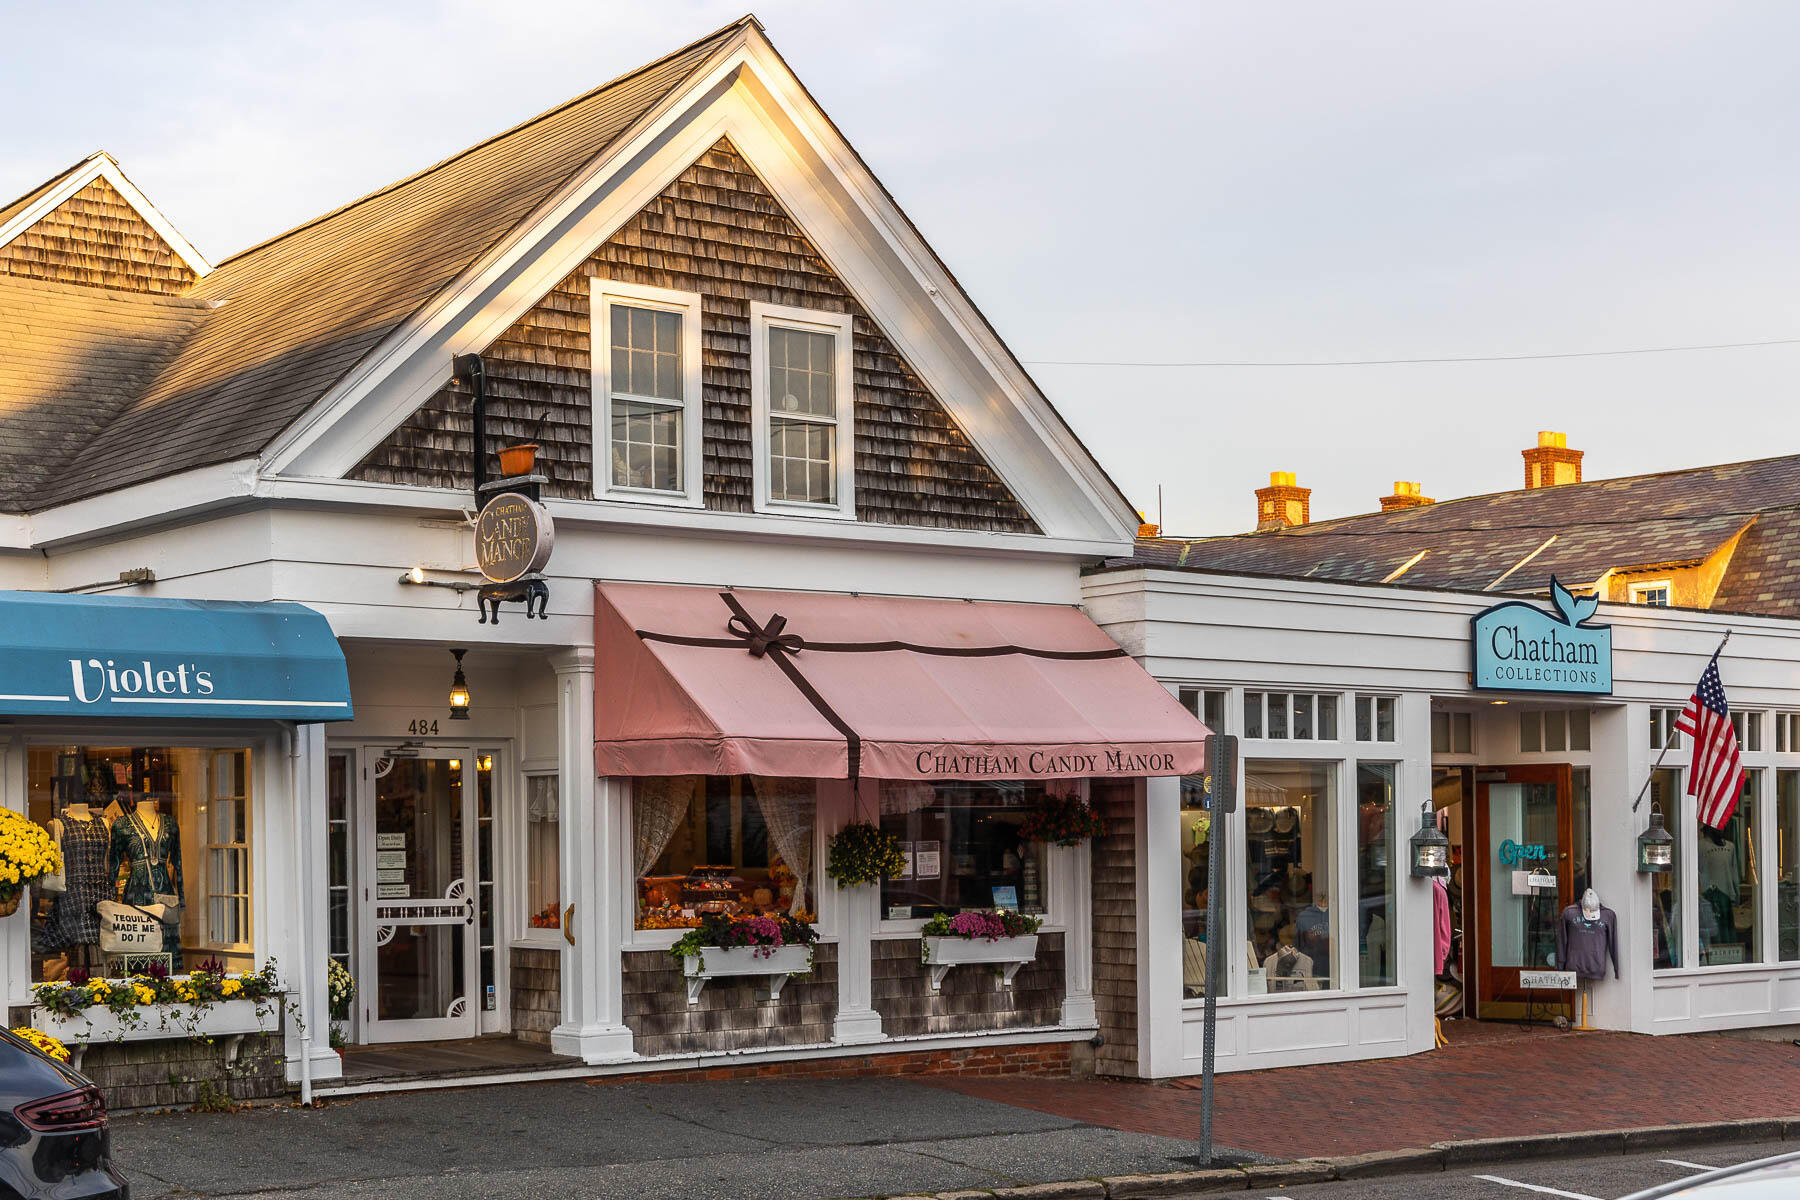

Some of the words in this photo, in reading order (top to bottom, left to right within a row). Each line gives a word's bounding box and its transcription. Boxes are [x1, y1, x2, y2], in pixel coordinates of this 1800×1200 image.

[481, 538, 531, 568] MANOR
[1492, 625, 1598, 664] Chatham
[69, 659, 214, 703] Violet's
[1496, 667, 1597, 683] COLLECTIONS
[408, 719, 439, 735] 484
[916, 750, 1019, 774] CHATHAM
[1029, 751, 1097, 774] CANDY
[1105, 750, 1175, 772] MANOR
[1499, 839, 1547, 868] Open
[113, 914, 153, 923] TEQUILA
[112, 923, 138, 932] MADE
[142, 924, 155, 932] ME
[121, 933, 133, 942] DO
[137, 934, 146, 943] IT
[1522, 975, 1571, 985] HATHA
